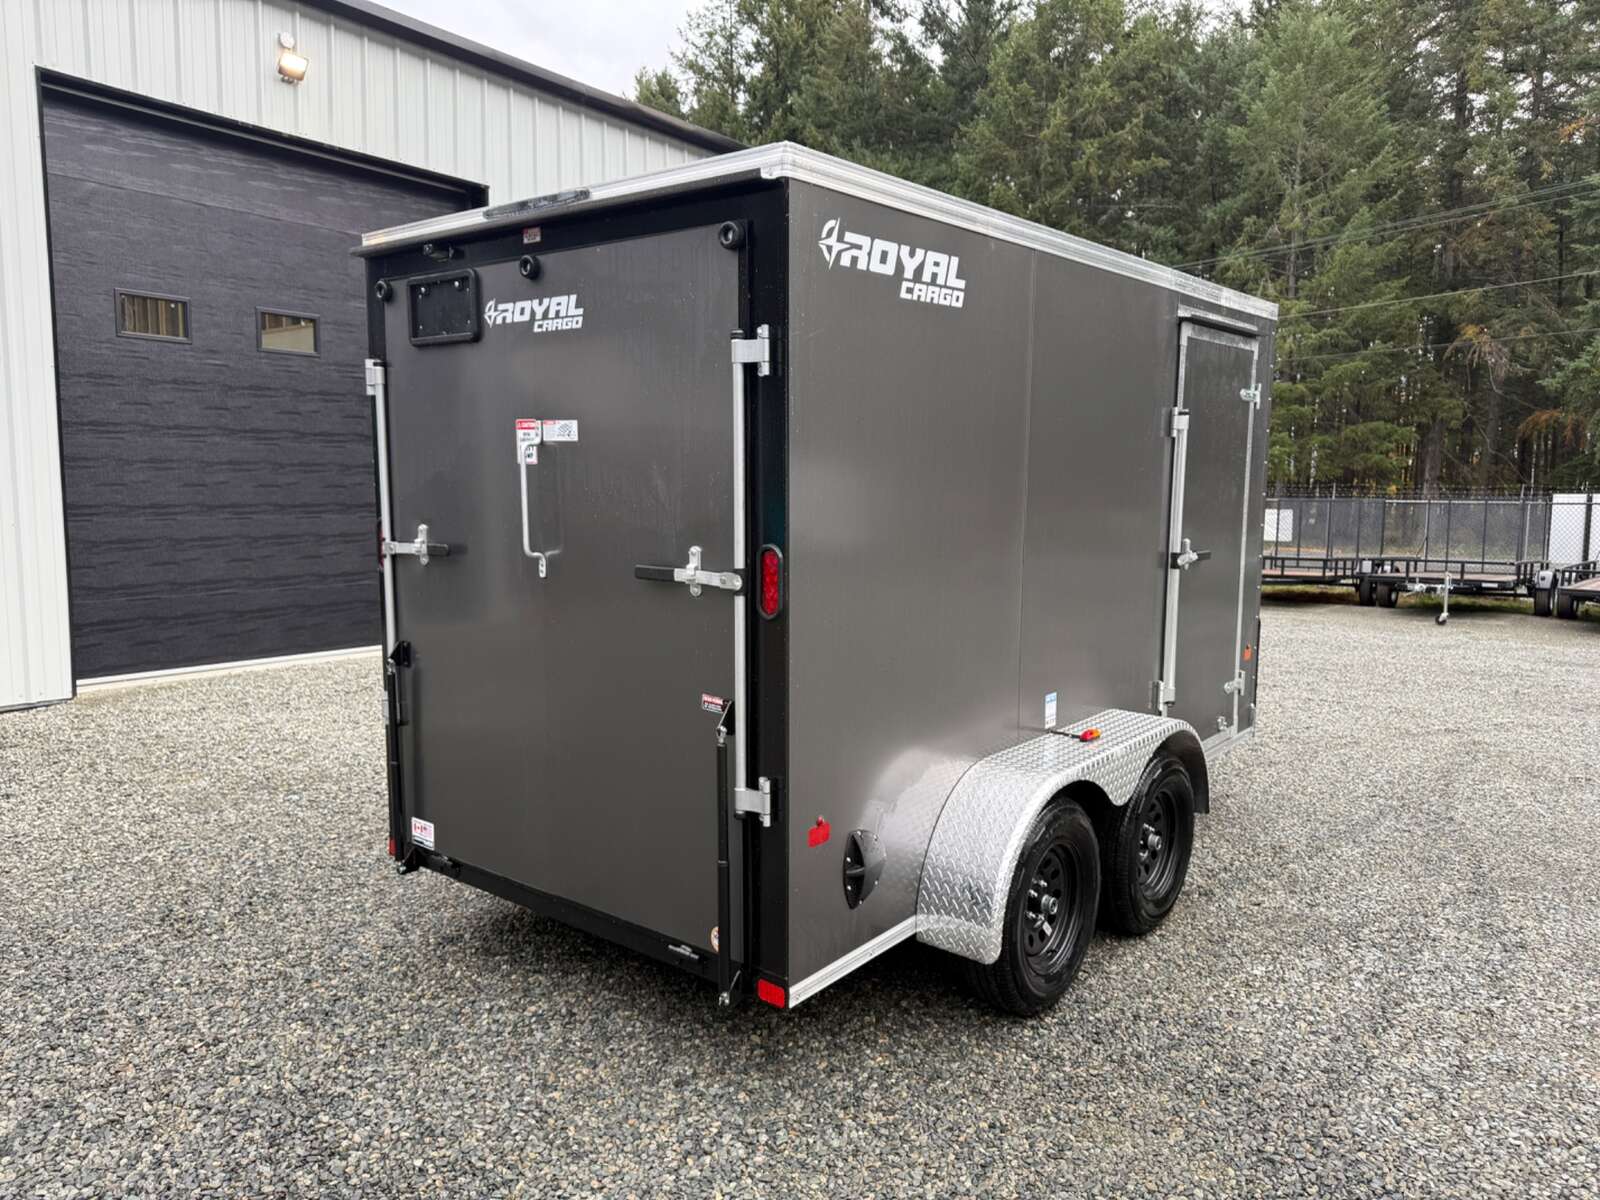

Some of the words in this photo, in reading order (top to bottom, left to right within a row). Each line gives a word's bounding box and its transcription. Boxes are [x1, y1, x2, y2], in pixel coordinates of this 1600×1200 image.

[840, 231, 966, 289] ROYAL
[899, 280, 965, 308] CARGO
[495, 294, 584, 325] ROYAL
[533, 316, 583, 333] CARGO
